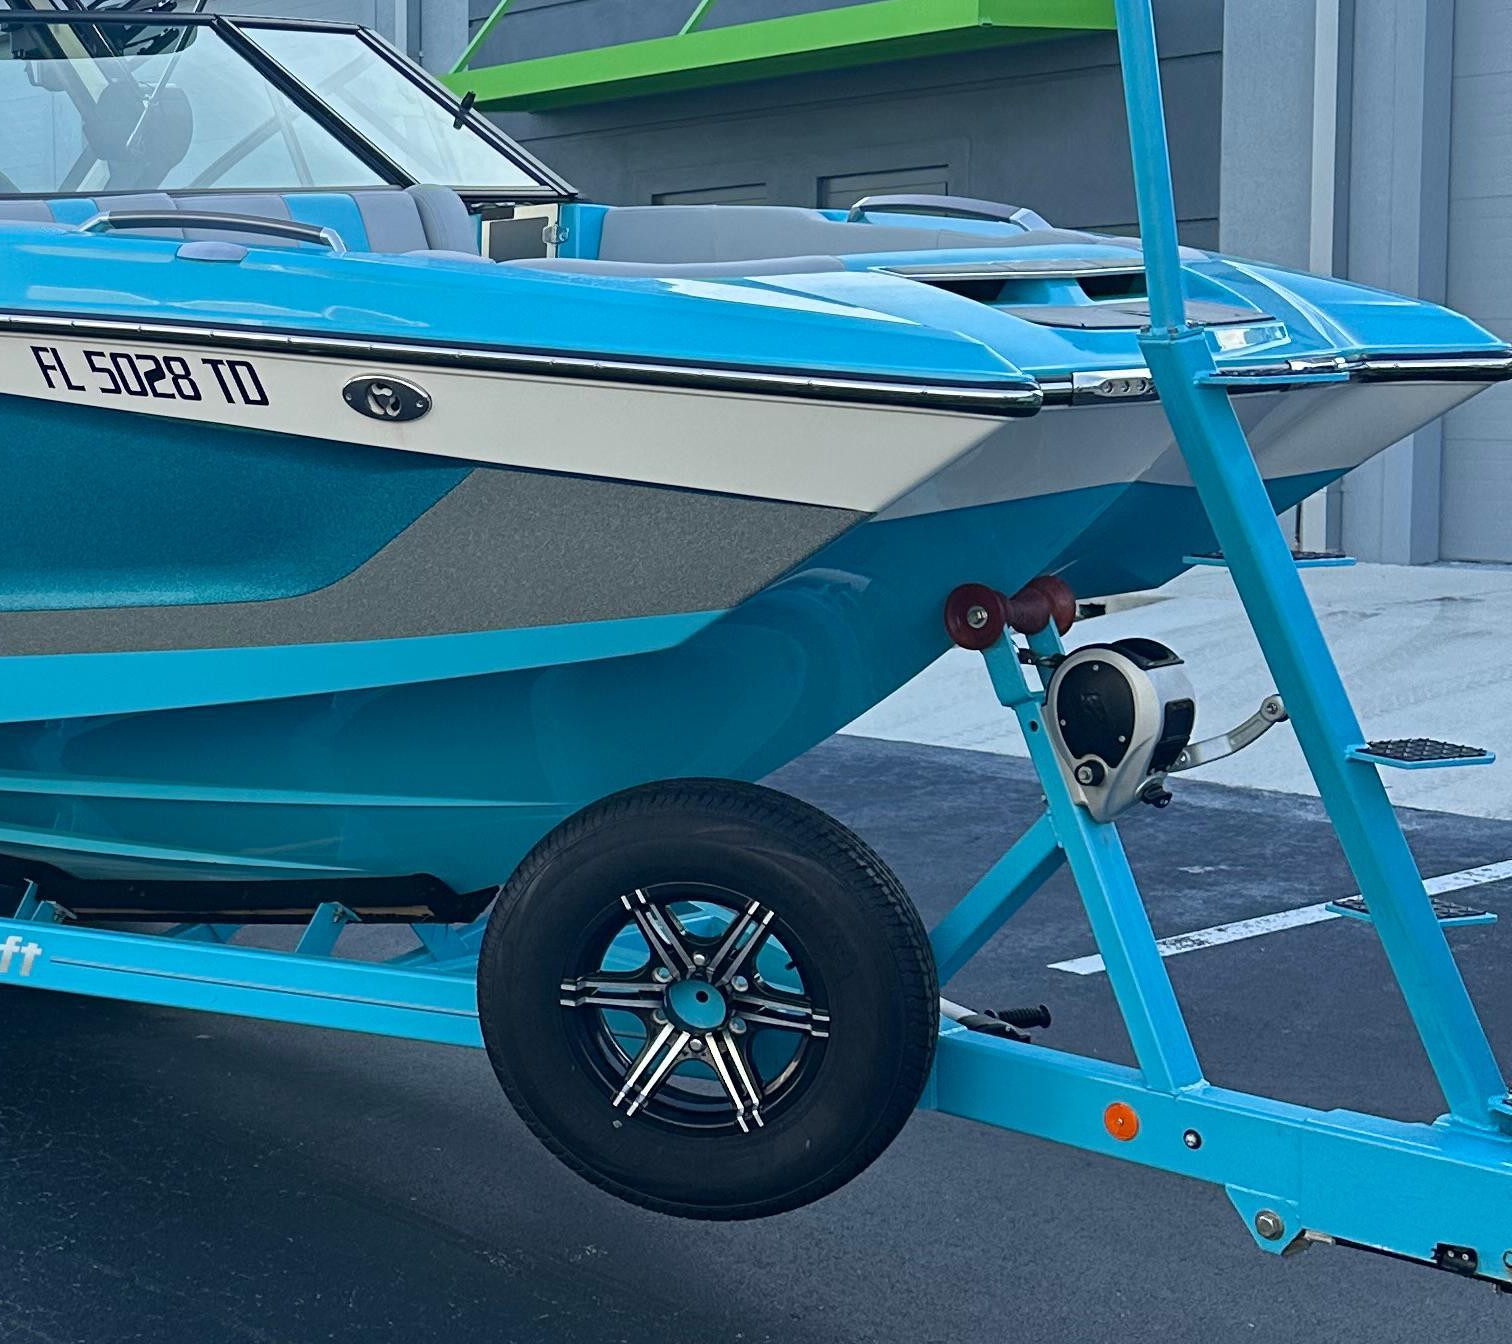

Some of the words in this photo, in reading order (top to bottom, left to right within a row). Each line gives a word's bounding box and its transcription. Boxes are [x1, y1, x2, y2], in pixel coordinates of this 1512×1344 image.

[30, 345, 86, 391] FL
[83, 350, 202, 401] 5028
[201, 358, 270, 406] TD
